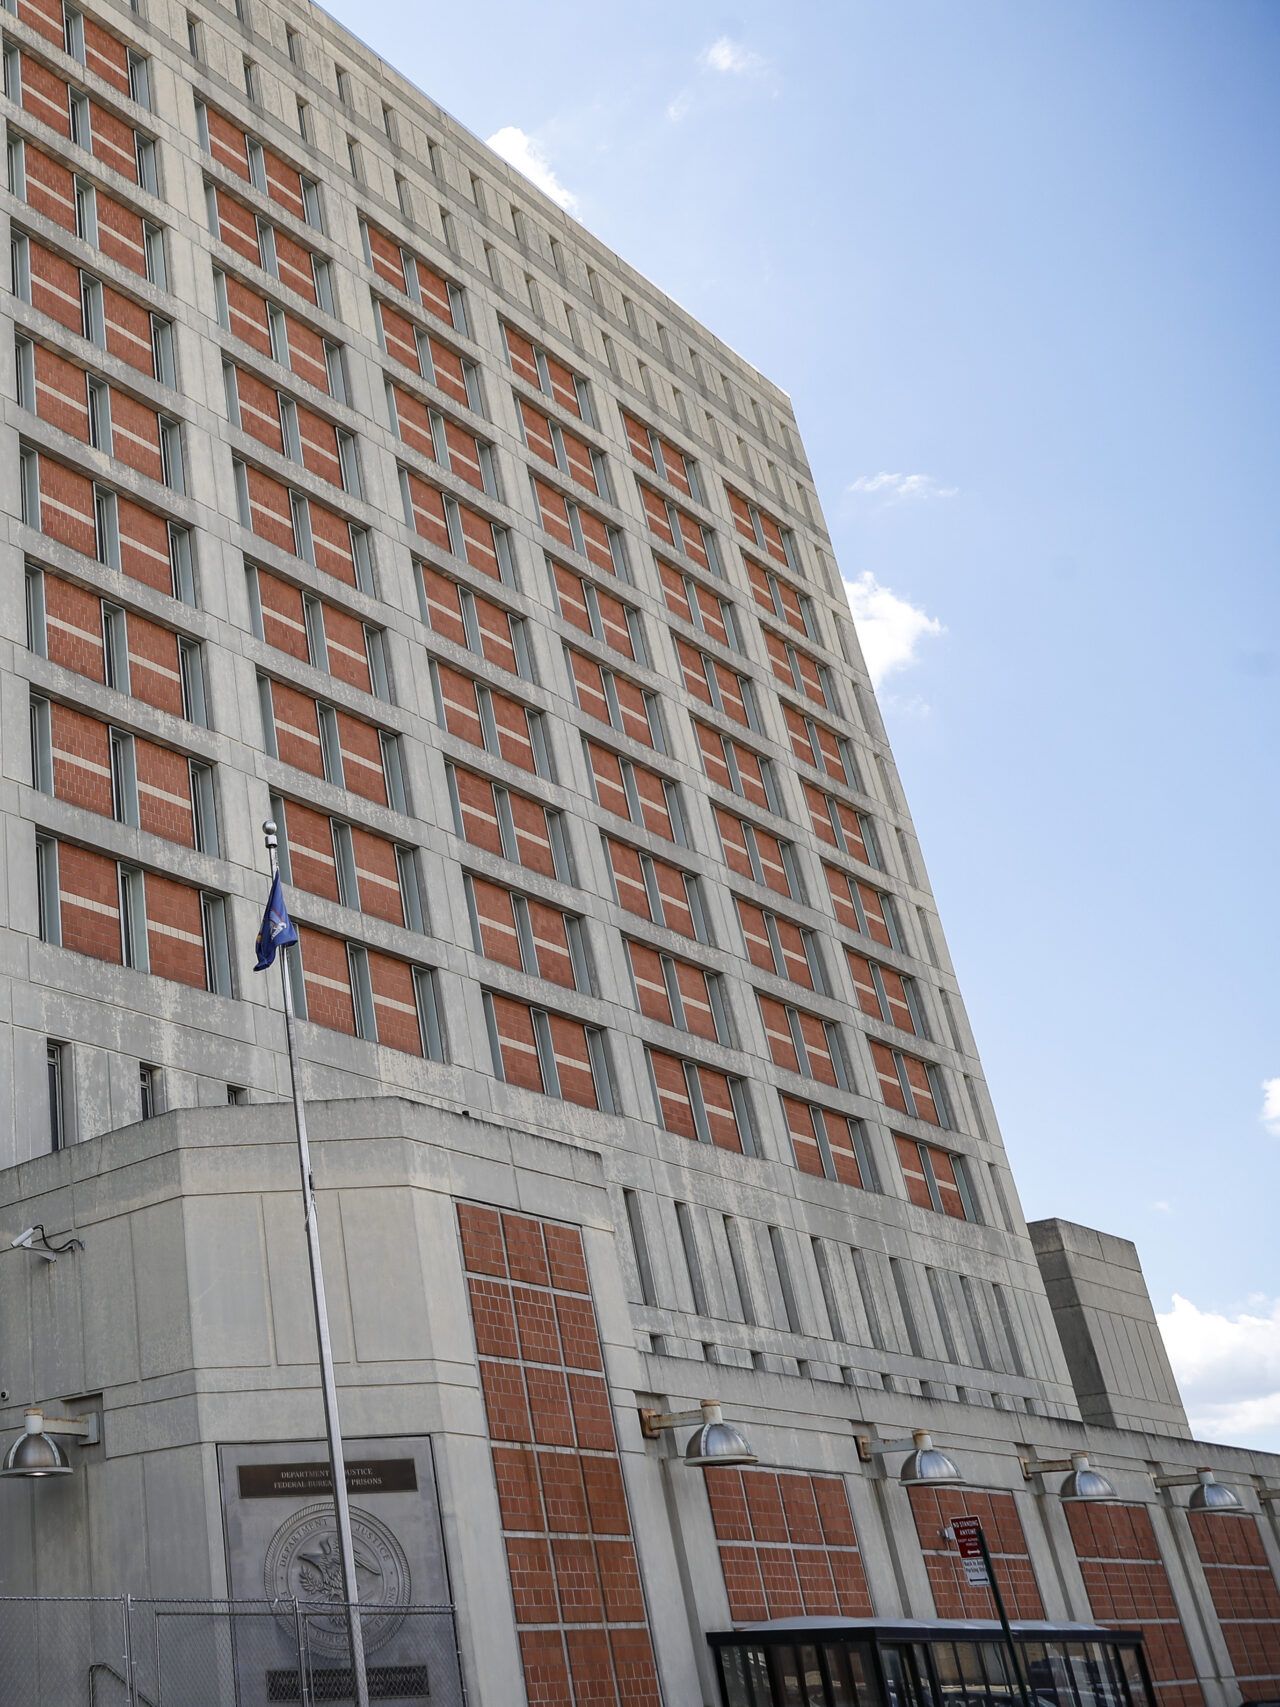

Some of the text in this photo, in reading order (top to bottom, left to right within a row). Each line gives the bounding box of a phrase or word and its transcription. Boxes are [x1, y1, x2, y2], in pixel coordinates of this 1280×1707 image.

[281, 1467, 373, 1479] DEPARTMENT USTICE
[273, 1481, 305, 1489] FEDERAL
[308, 1480, 333, 1488] BUREA
[351, 1477, 383, 1486] PRISONS
[959, 1520, 979, 1528] STANDING
[279, 1518, 391, 1567] DEPARTMENT JUSTICE
[315, 1631, 349, 1643] BUREA
